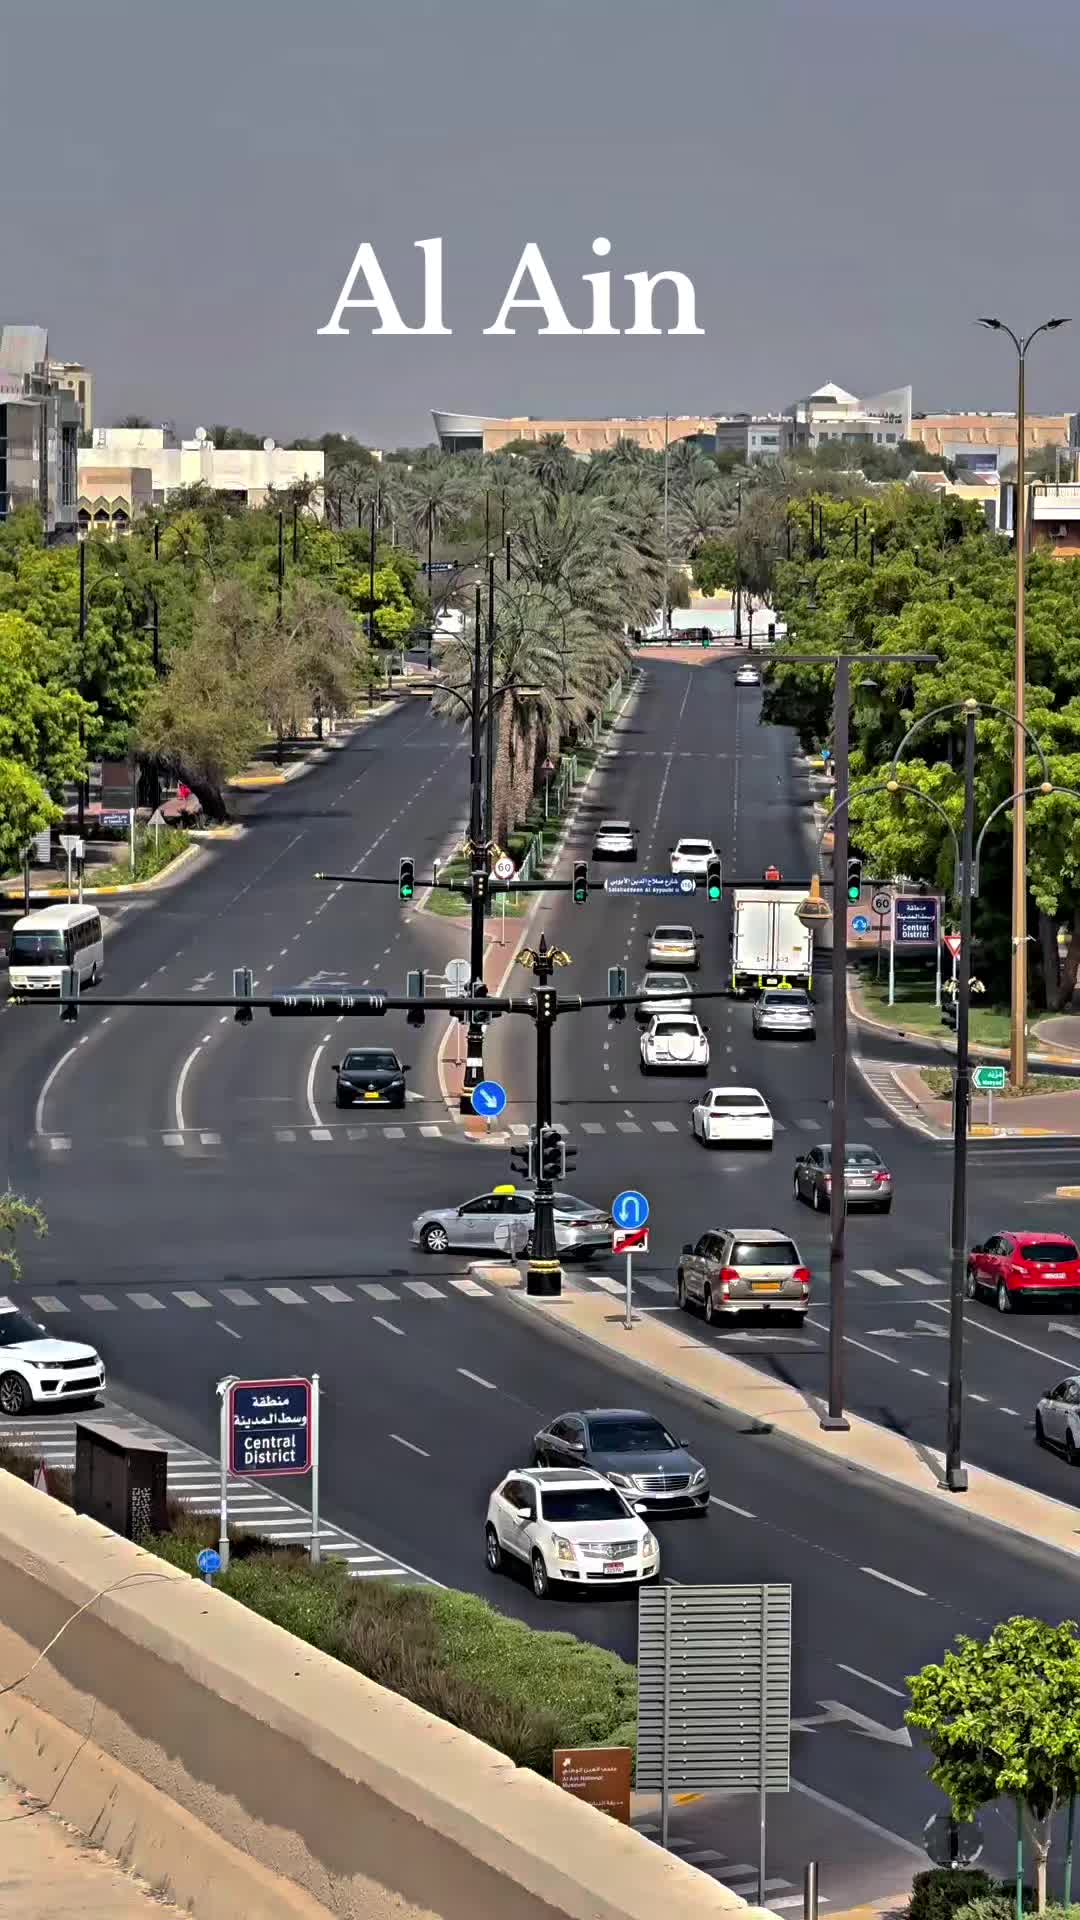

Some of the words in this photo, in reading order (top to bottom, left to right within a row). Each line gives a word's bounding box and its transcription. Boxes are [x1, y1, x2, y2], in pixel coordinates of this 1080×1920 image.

[498, 863, 511, 872] 60
[876, 899, 889, 908] 60
[919, 913, 936, 921] وسط
[251, 1395, 290, 1407] منطقة
[233, 1412, 278, 1429] المدينة
[277, 1412, 307, 1427] وسط
[244, 1434, 296, 1450] Central
[244, 1448, 296, 1465] District
